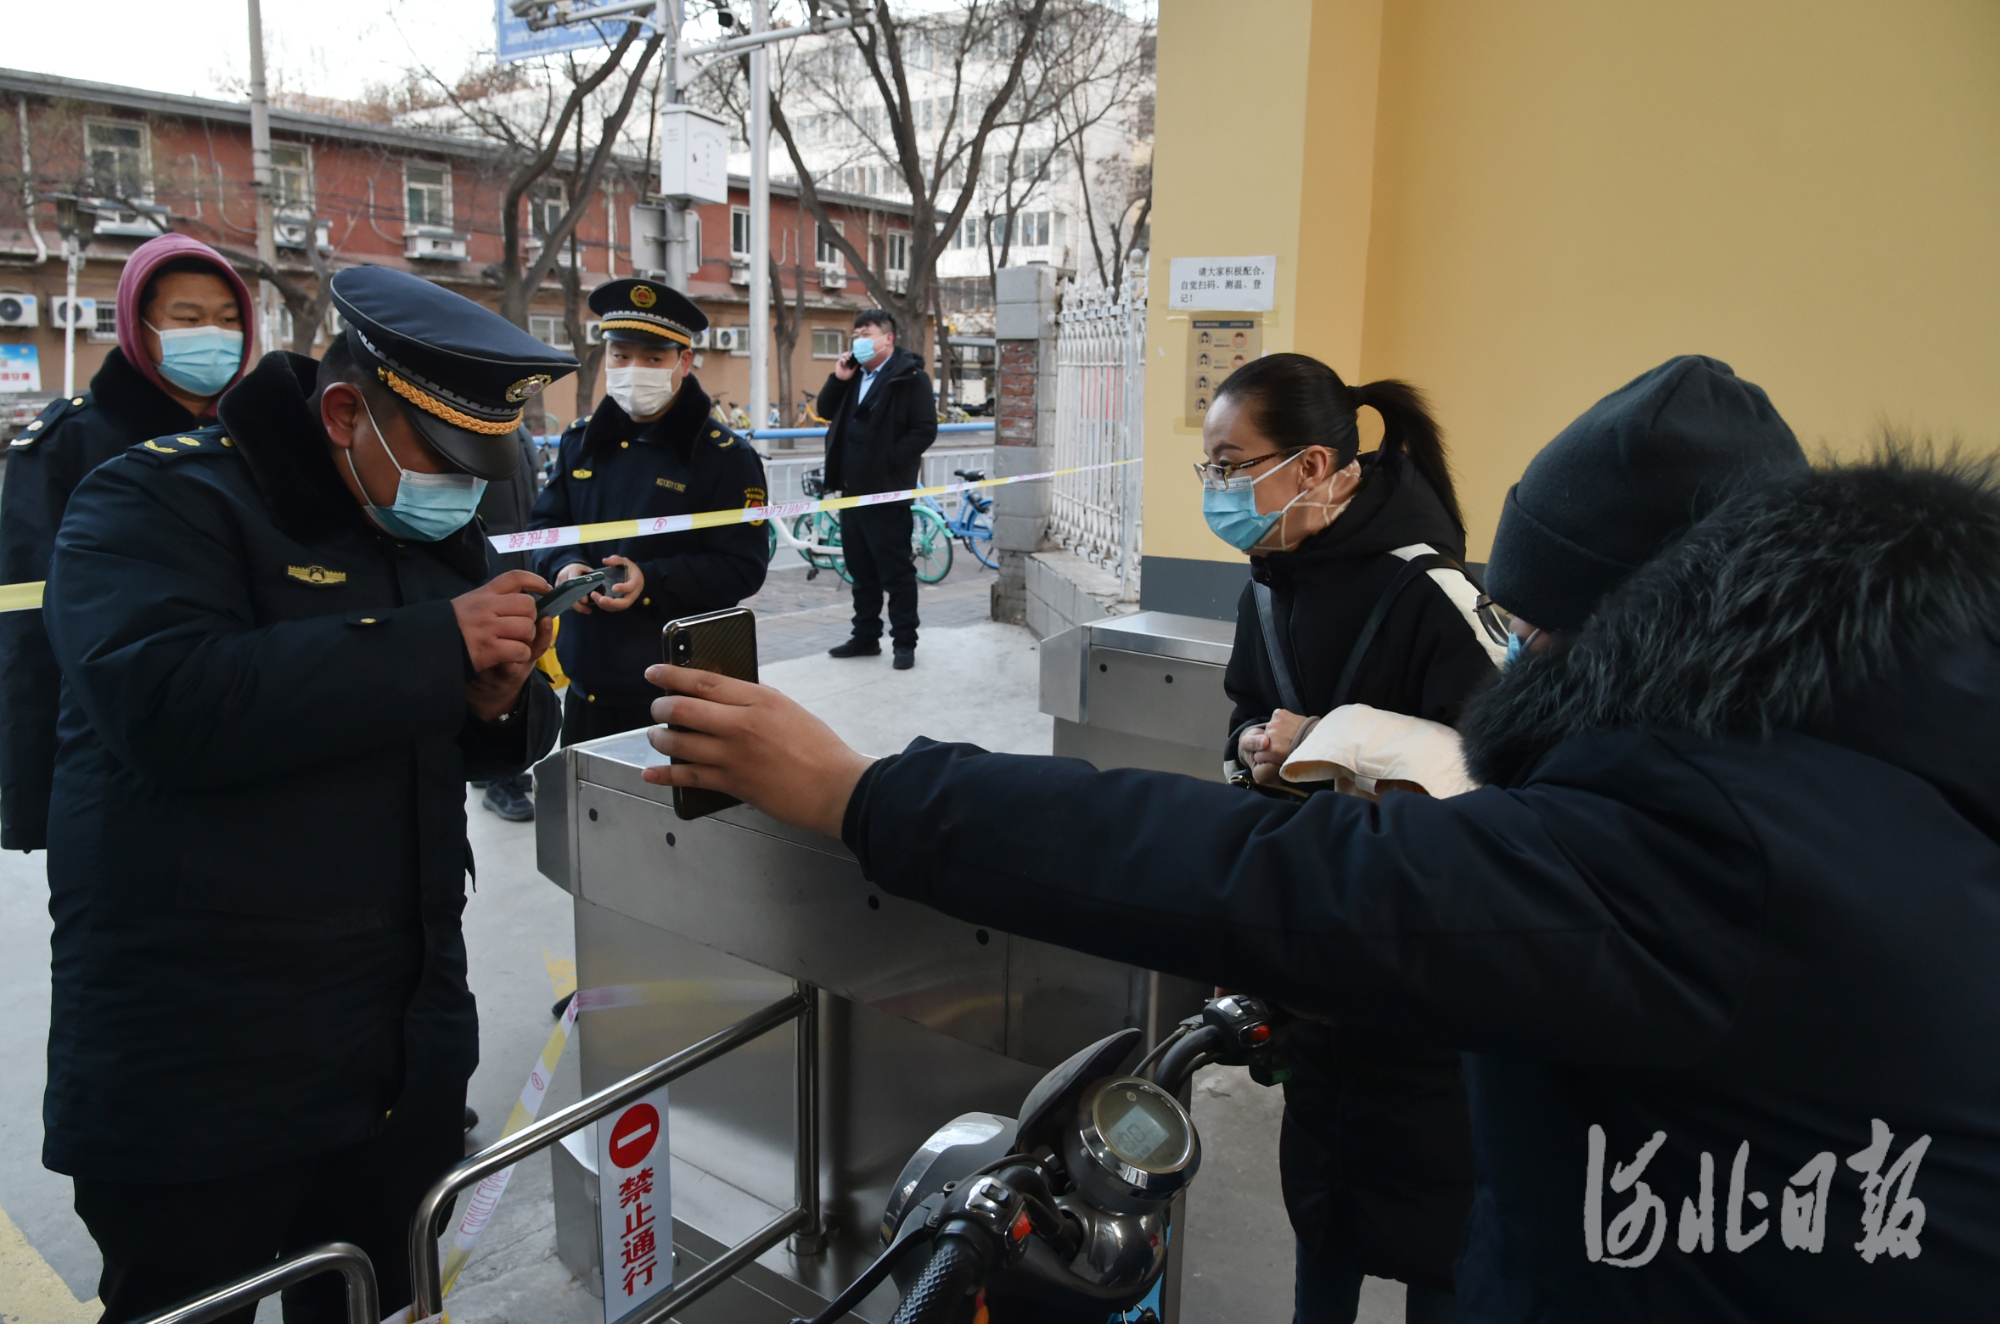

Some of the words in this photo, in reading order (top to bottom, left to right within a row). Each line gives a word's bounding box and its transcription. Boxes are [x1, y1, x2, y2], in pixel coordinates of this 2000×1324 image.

[1181, 279, 1262, 290] 自觉扫码、测温、登
[618, 1166, 658, 1297] 禁止通行
